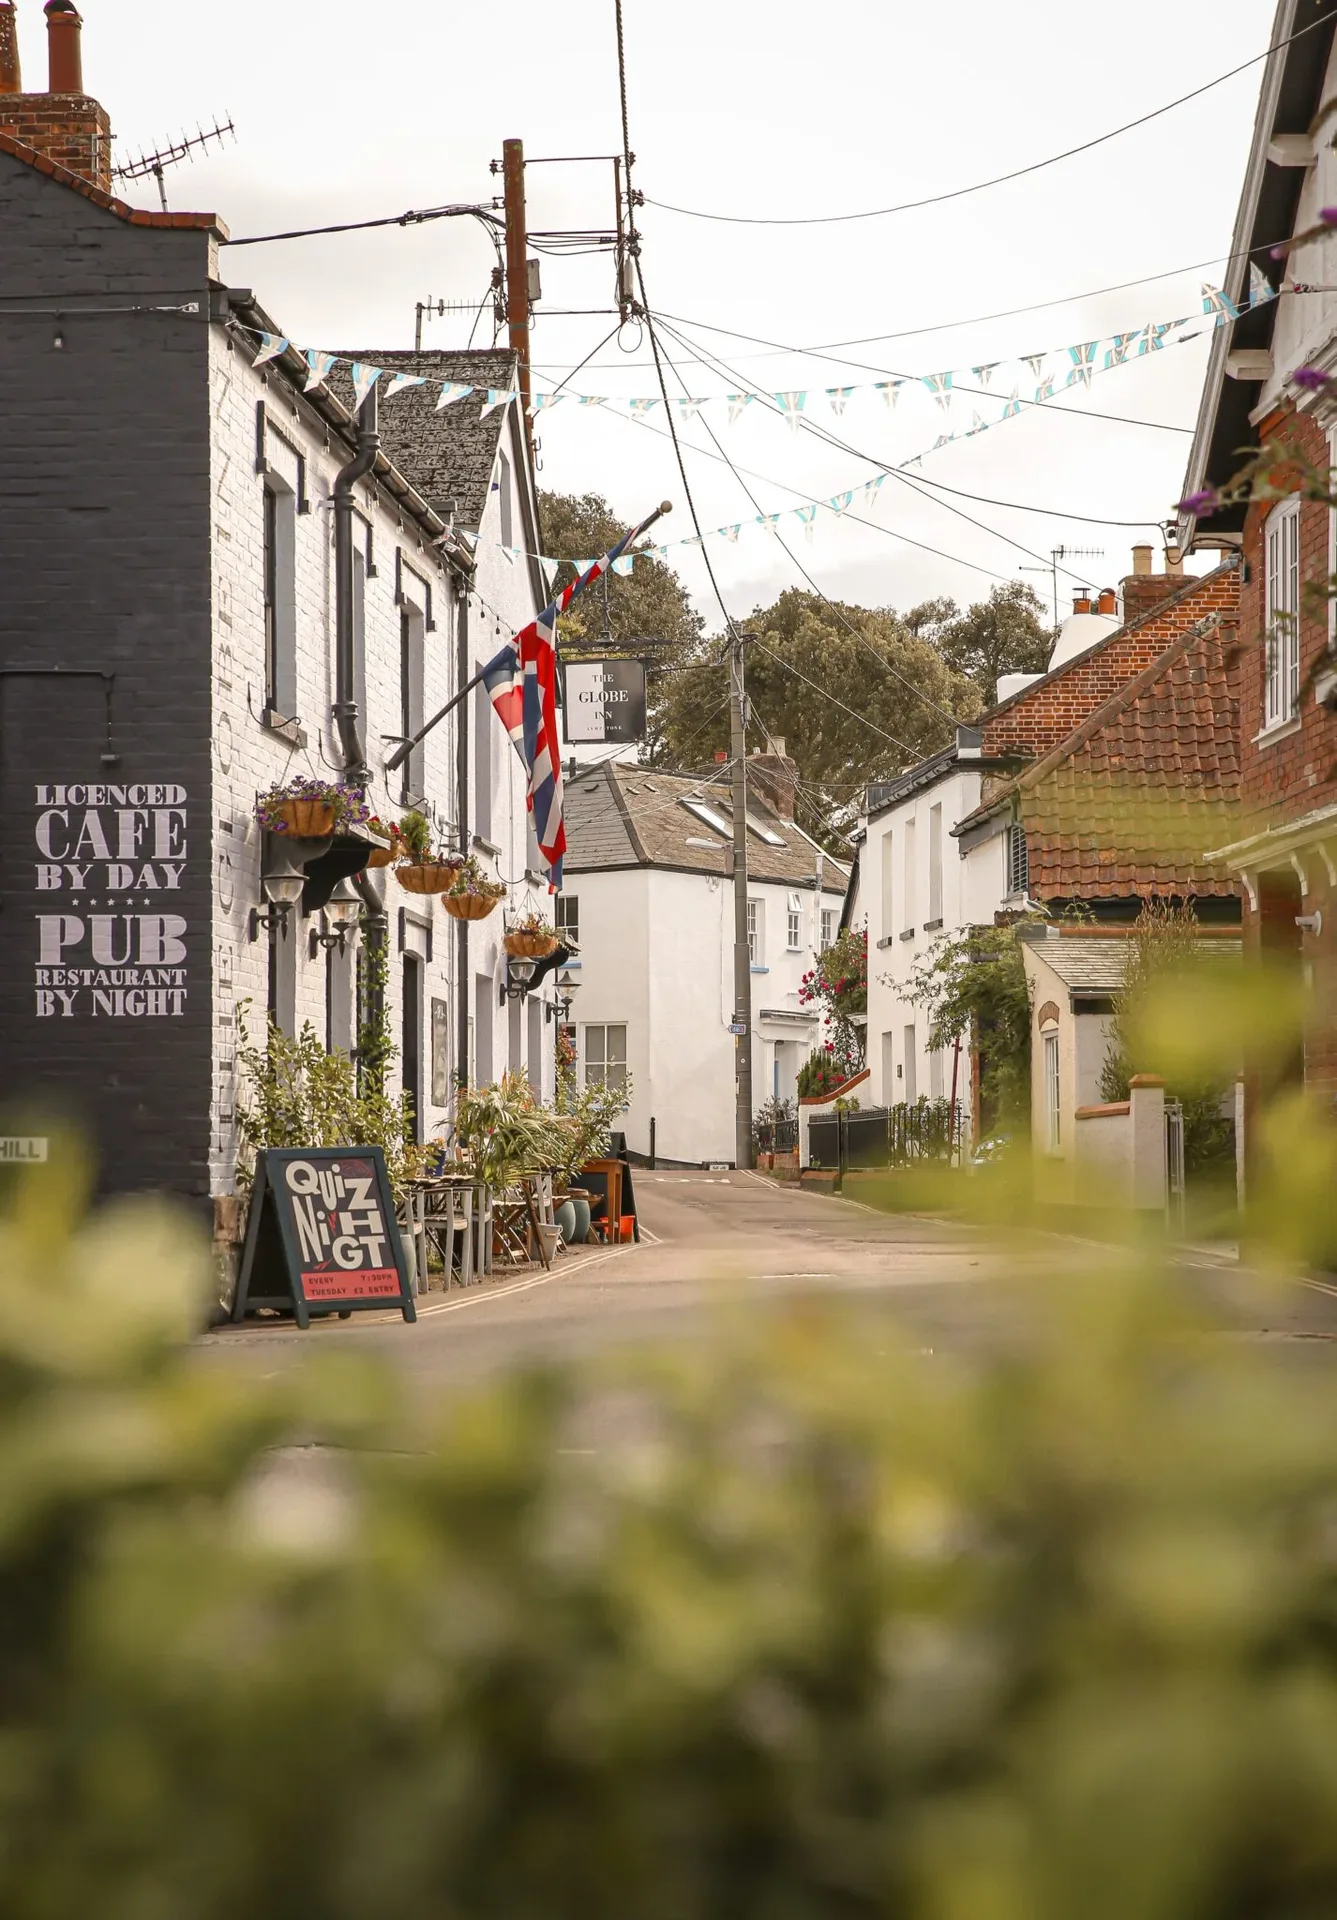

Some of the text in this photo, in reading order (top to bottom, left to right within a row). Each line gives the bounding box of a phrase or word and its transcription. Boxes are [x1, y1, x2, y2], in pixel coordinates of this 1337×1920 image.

[592, 674, 614, 683] THE
[578, 690, 629, 703] GLOBE
[594, 711, 613, 719] INN
[35, 784, 187, 806] LICENCED
[35, 808, 187, 860] CAFE
[35, 864, 187, 890] BY DAY
[35, 914, 187, 966] PUB
[35, 969, 187, 986] RESTAURANT
[35, 989, 187, 1017] BY NIGHT
[308, 1276, 334, 1284] EVERY
[311, 1287, 346, 1296] TUESDAY
[368, 1285, 394, 1293] ENTRY
